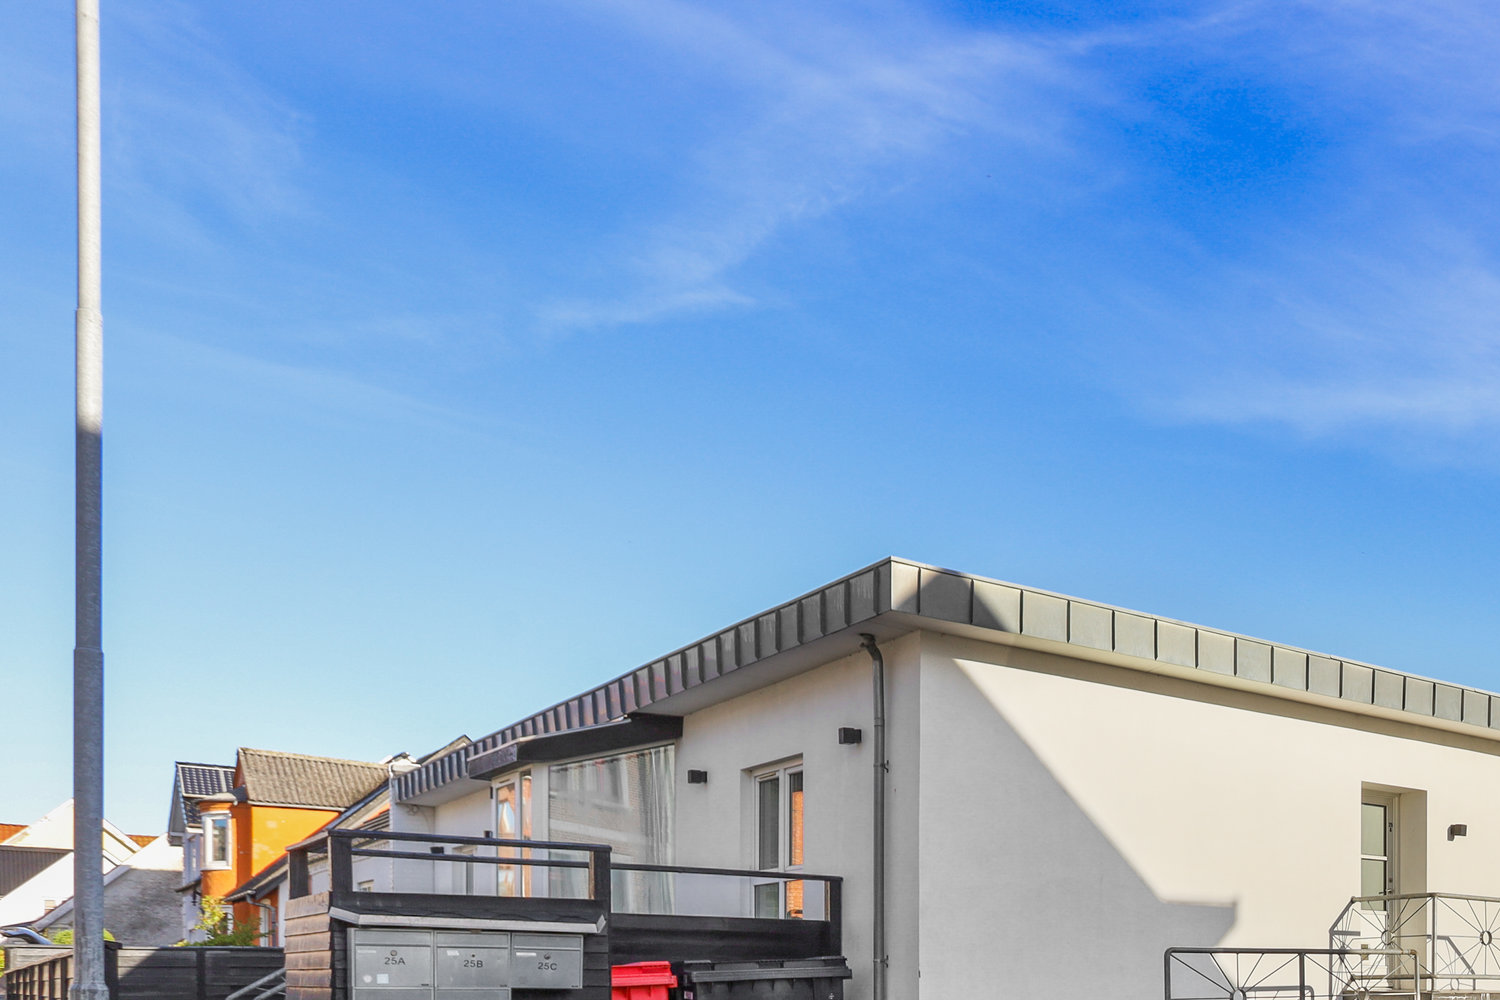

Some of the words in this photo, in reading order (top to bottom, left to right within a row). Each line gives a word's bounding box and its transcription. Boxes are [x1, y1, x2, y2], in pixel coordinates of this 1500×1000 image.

[384, 956, 406, 966] 25A
[463, 959, 484, 969] 25B
[537, 962, 558, 971] 25C
